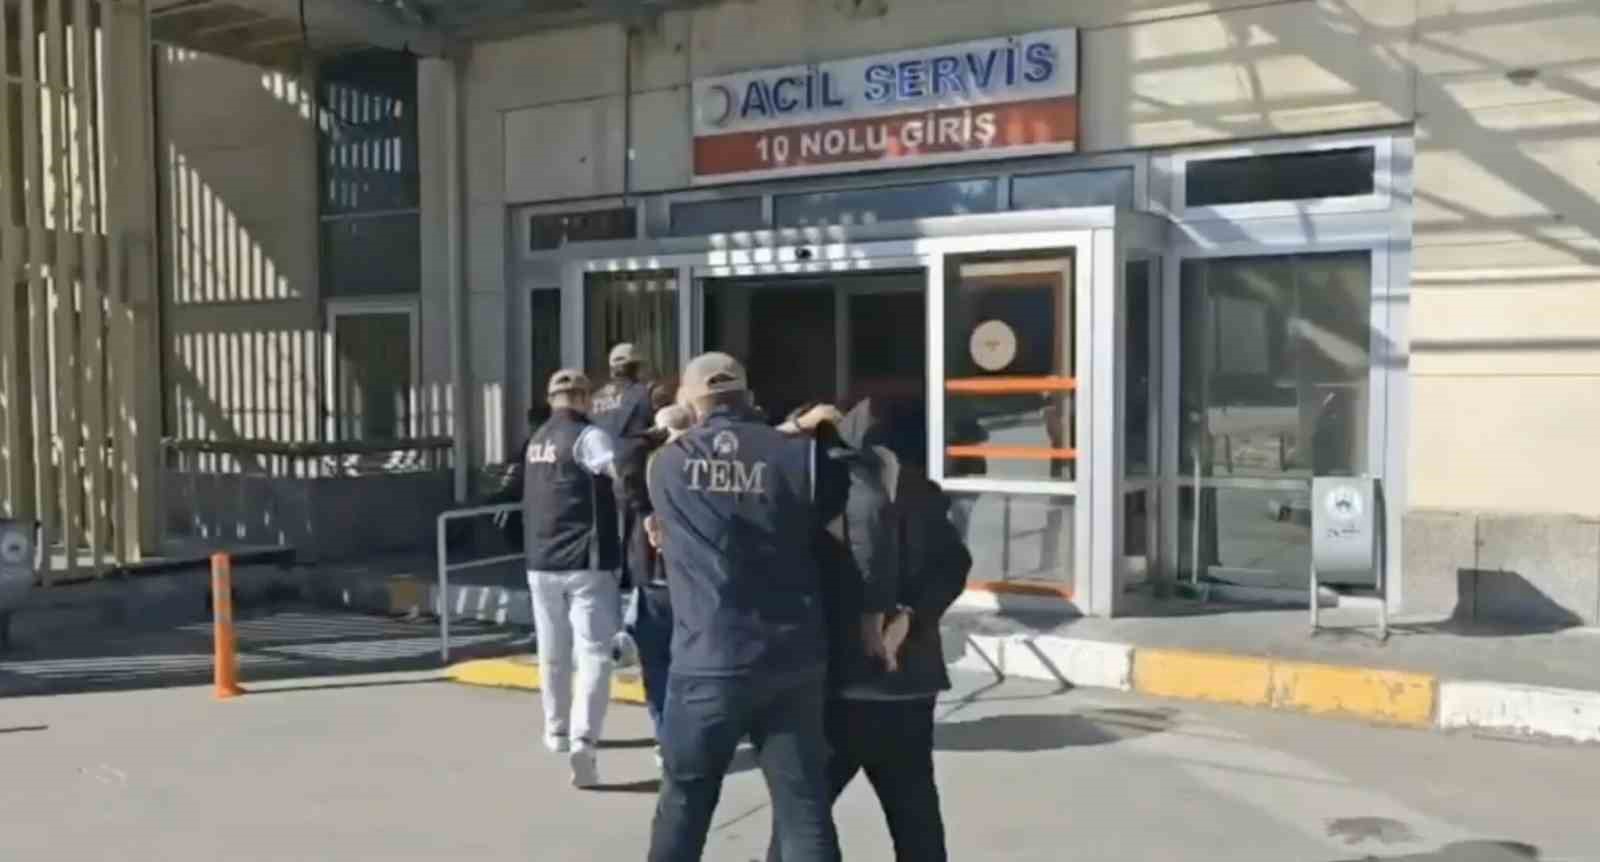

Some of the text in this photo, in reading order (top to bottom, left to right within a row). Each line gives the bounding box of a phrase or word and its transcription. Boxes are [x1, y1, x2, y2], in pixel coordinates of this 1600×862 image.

[740, 37, 1055, 118] ACİL SERVİS
[756, 134, 790, 162] 10
[800, 123, 888, 158] NOLU
[683, 458, 767, 494] TEM
